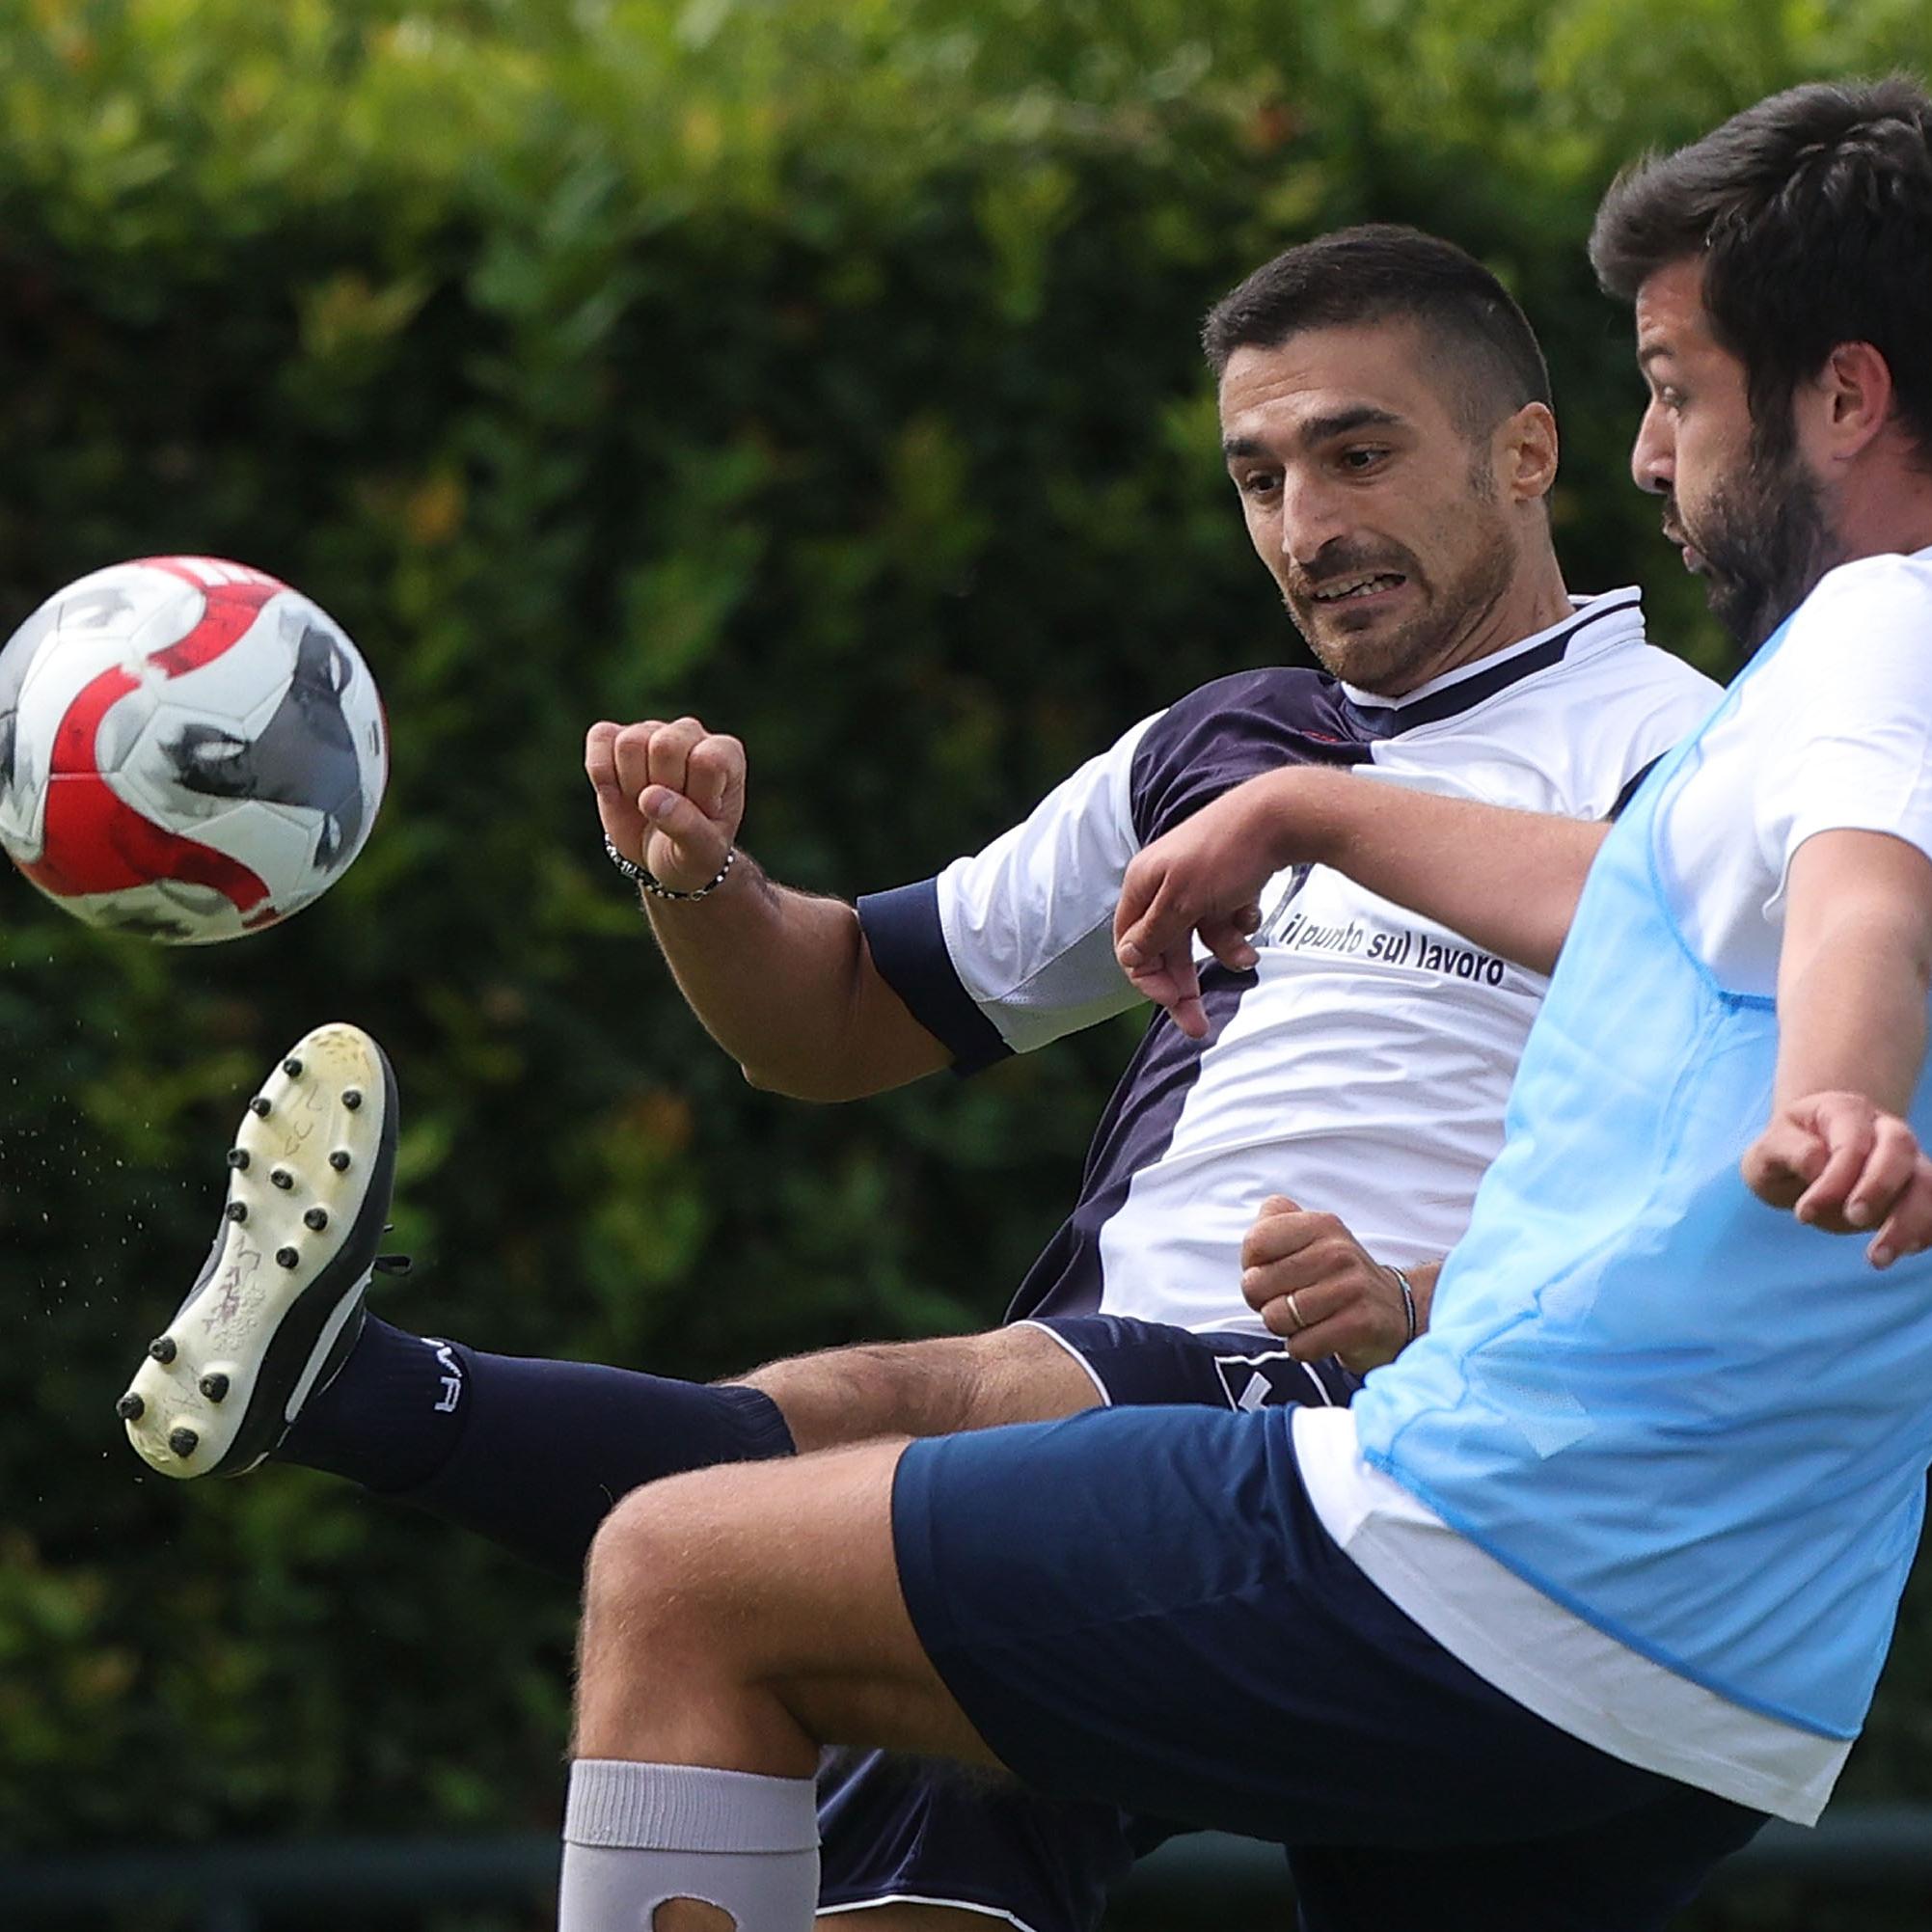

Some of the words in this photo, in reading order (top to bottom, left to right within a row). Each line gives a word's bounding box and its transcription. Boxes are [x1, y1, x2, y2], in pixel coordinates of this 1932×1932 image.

[1279, 912, 1308, 944] il
[1295, 920, 1363, 952] punto
[1367, 930, 1411, 965] sul
[1416, 935, 1505, 986] lavoro
